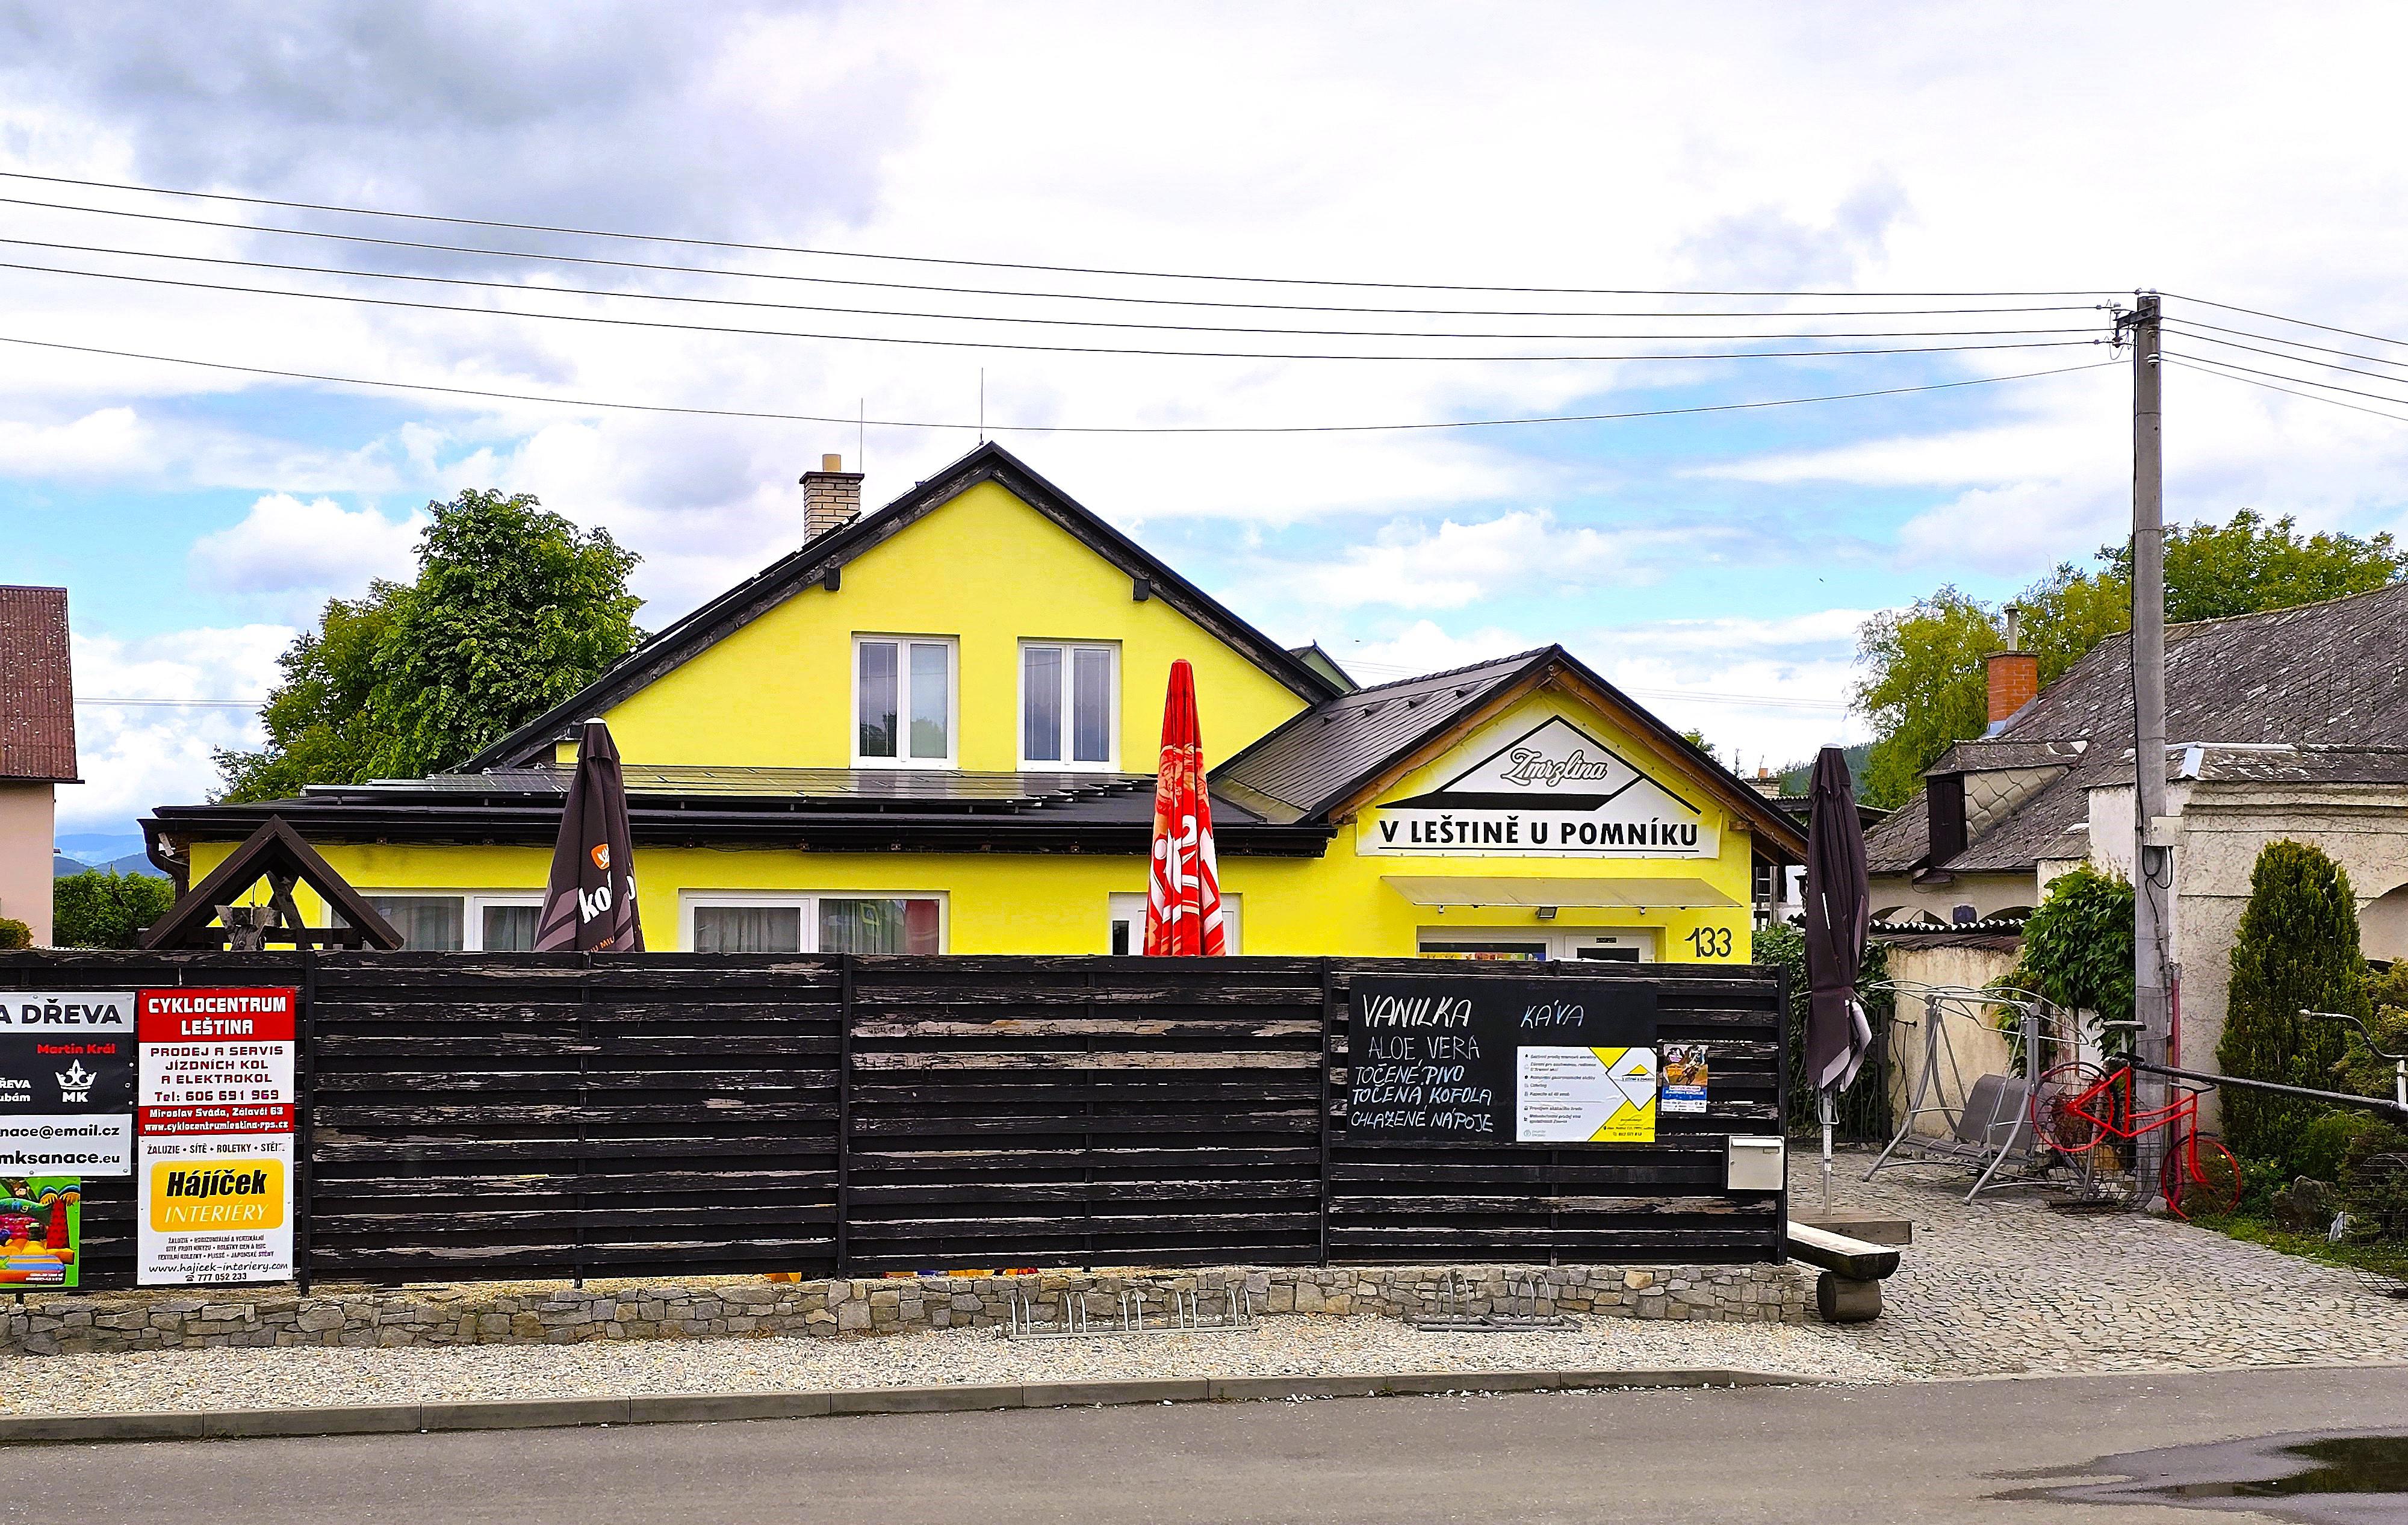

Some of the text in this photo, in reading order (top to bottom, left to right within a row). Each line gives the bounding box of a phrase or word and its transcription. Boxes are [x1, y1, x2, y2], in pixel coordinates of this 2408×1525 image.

[1500, 747, 1608, 787] Zmrzlina
[1379, 815, 1698, 846] V LEŠTINĚ U POMNÍKU
[1685, 927, 1733, 957] 133
[22, 998, 123, 1024] DŘEVA
[148, 996, 286, 1013] CYKLOCENTRUM
[1363, 994, 1472, 1028] VANILKA
[1520, 999, 1584, 1029] KÁVA
[181, 1016, 253, 1036] LEŠTINA
[37, 1043, 116, 1054] Martin Král
[150, 1046, 284, 1057] PRODEJ A SERVIS
[1368, 1034, 1480, 1060] ALOE VERA
[165, 1058, 268, 1070] JÍZDNÍCH KOL
[1354, 1058, 1465, 1086] TOČENÉ PIVO
[161, 1073, 273, 1084] A ELEKTROKOL
[62, 1092, 88, 1102] MK
[154, 1089, 279, 1102] Tel: 606 691 969
[1429, 1087, 1492, 1106] KOFOLA
[149, 1108, 193, 1118] Miroslav
[1430, 1107, 1494, 1132] NÁPOJE
[147, 1143, 181, 1155] ŽALUZIE
[190, 1142, 207, 1154] SÍTĚ
[216, 1143, 252, 1153] ROLETKY
[166, 1169, 268, 1199] Hájíček
[164, 1200, 269, 1223] INTERIÉRY
[149, 1261, 288, 1273] www.hajicek-interiery.com
[197, 1273, 213, 1282] 777
[232, 1272, 247, 1281] 233
